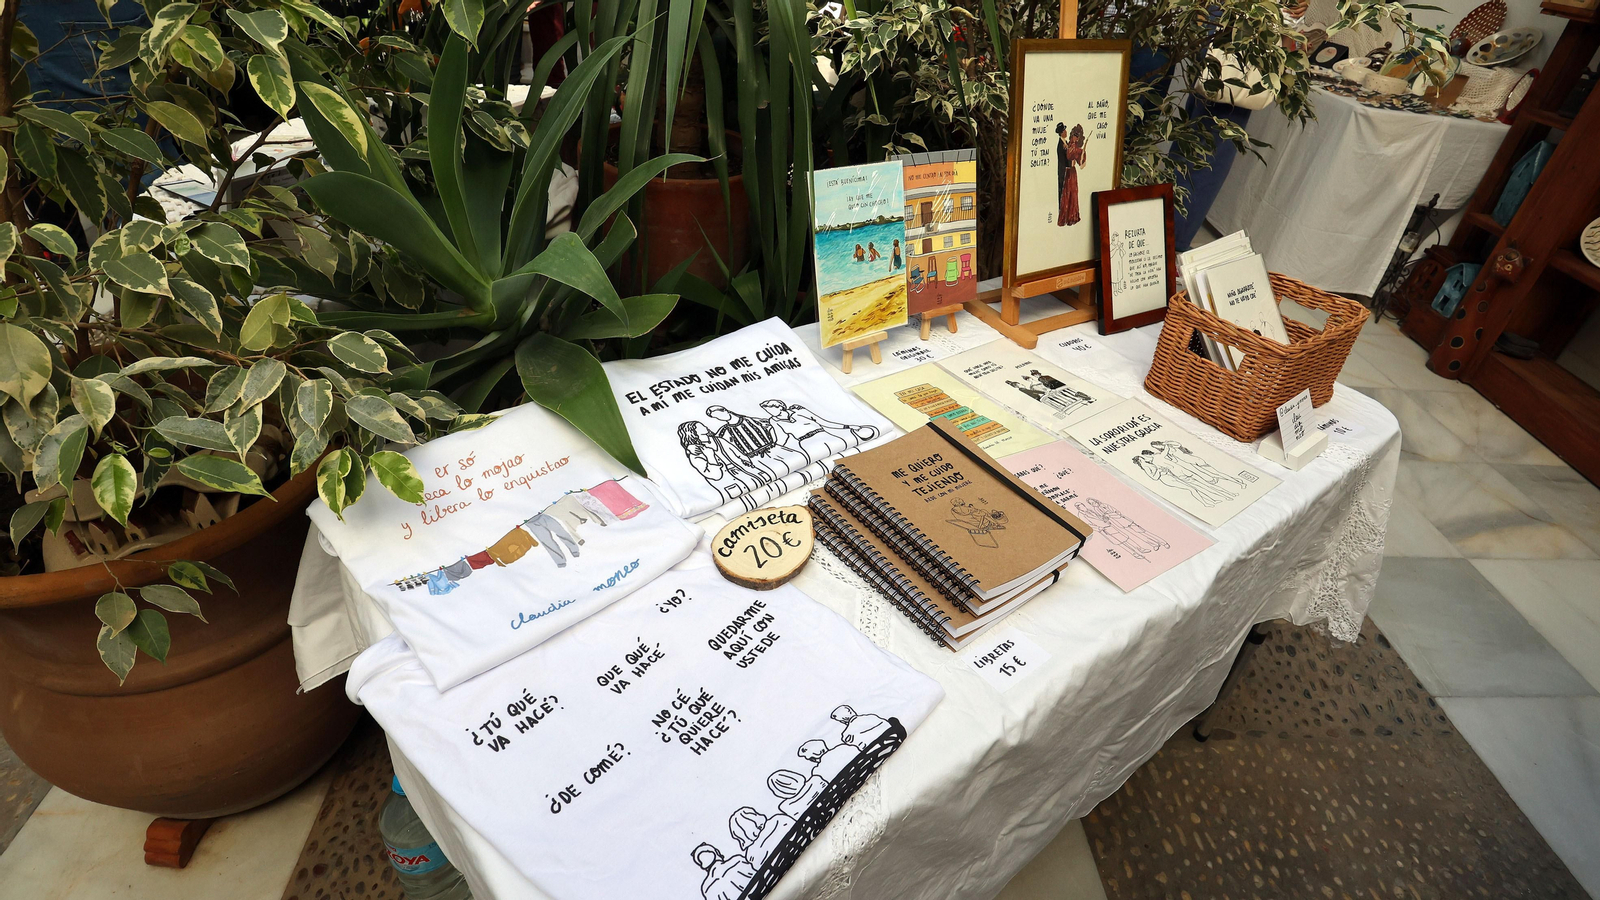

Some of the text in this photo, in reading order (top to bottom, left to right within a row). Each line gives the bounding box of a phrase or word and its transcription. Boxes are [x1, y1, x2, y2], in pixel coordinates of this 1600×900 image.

[1033, 114, 1054, 123] VA UNA
[1088, 112, 1097, 120] QUE
[1097, 122, 1108, 130] CAGO
[1031, 147, 1050, 157] TÚ TAN
[1032, 137, 1047, 146] COMO
[1030, 158, 1050, 168] SOLITA?
[1128, 240, 1135, 249] DE
[625, 341, 793, 405] EL ESTADO NO ME CUIDA
[639, 357, 802, 417] A MÍ ME CUIDAN MIS AMIGAS
[1088, 437, 1103, 446] LA
[1137, 414, 1151, 422] ES
[1102, 434, 1138, 454] NUESTRA
[434, 451, 477, 479] er só
[455, 476, 473, 492] lo
[481, 453, 526, 480] mojao
[891, 453, 943, 479] ME QUIERO
[913, 474, 929, 484] ME
[929, 463, 954, 477] CUIDO
[401, 455, 571, 540] y libera lo enquistao
[911, 471, 964, 497] TEJIENDO
[717, 510, 803, 558] camiseta
[510, 597, 577, 630] claudia
[654, 589, 693, 615] ¿YO?
[707, 599, 767, 651] QUEDARME
[722, 612, 776, 661] AQUÍ CON
[596, 636, 651, 687] QUE QUÉ
[736, 631, 781, 669] USTEDE
[973, 639, 1016, 670] LIBRETAS
[999, 655, 1027, 678] 15 €
[610, 642, 666, 695] VA HACÉ
[465, 688, 538, 747] ¿TÚ QUÉ
[487, 694, 565, 753] VA HACÉ?
[651, 688, 691, 728] NO CÉ
[654, 686, 715, 743] ¿TÚ QUÉ
[677, 701, 726, 745] QUIERE
[689, 709, 742, 756] HACÉ?
[544, 742, 631, 815] ¿DE COMÉ?
